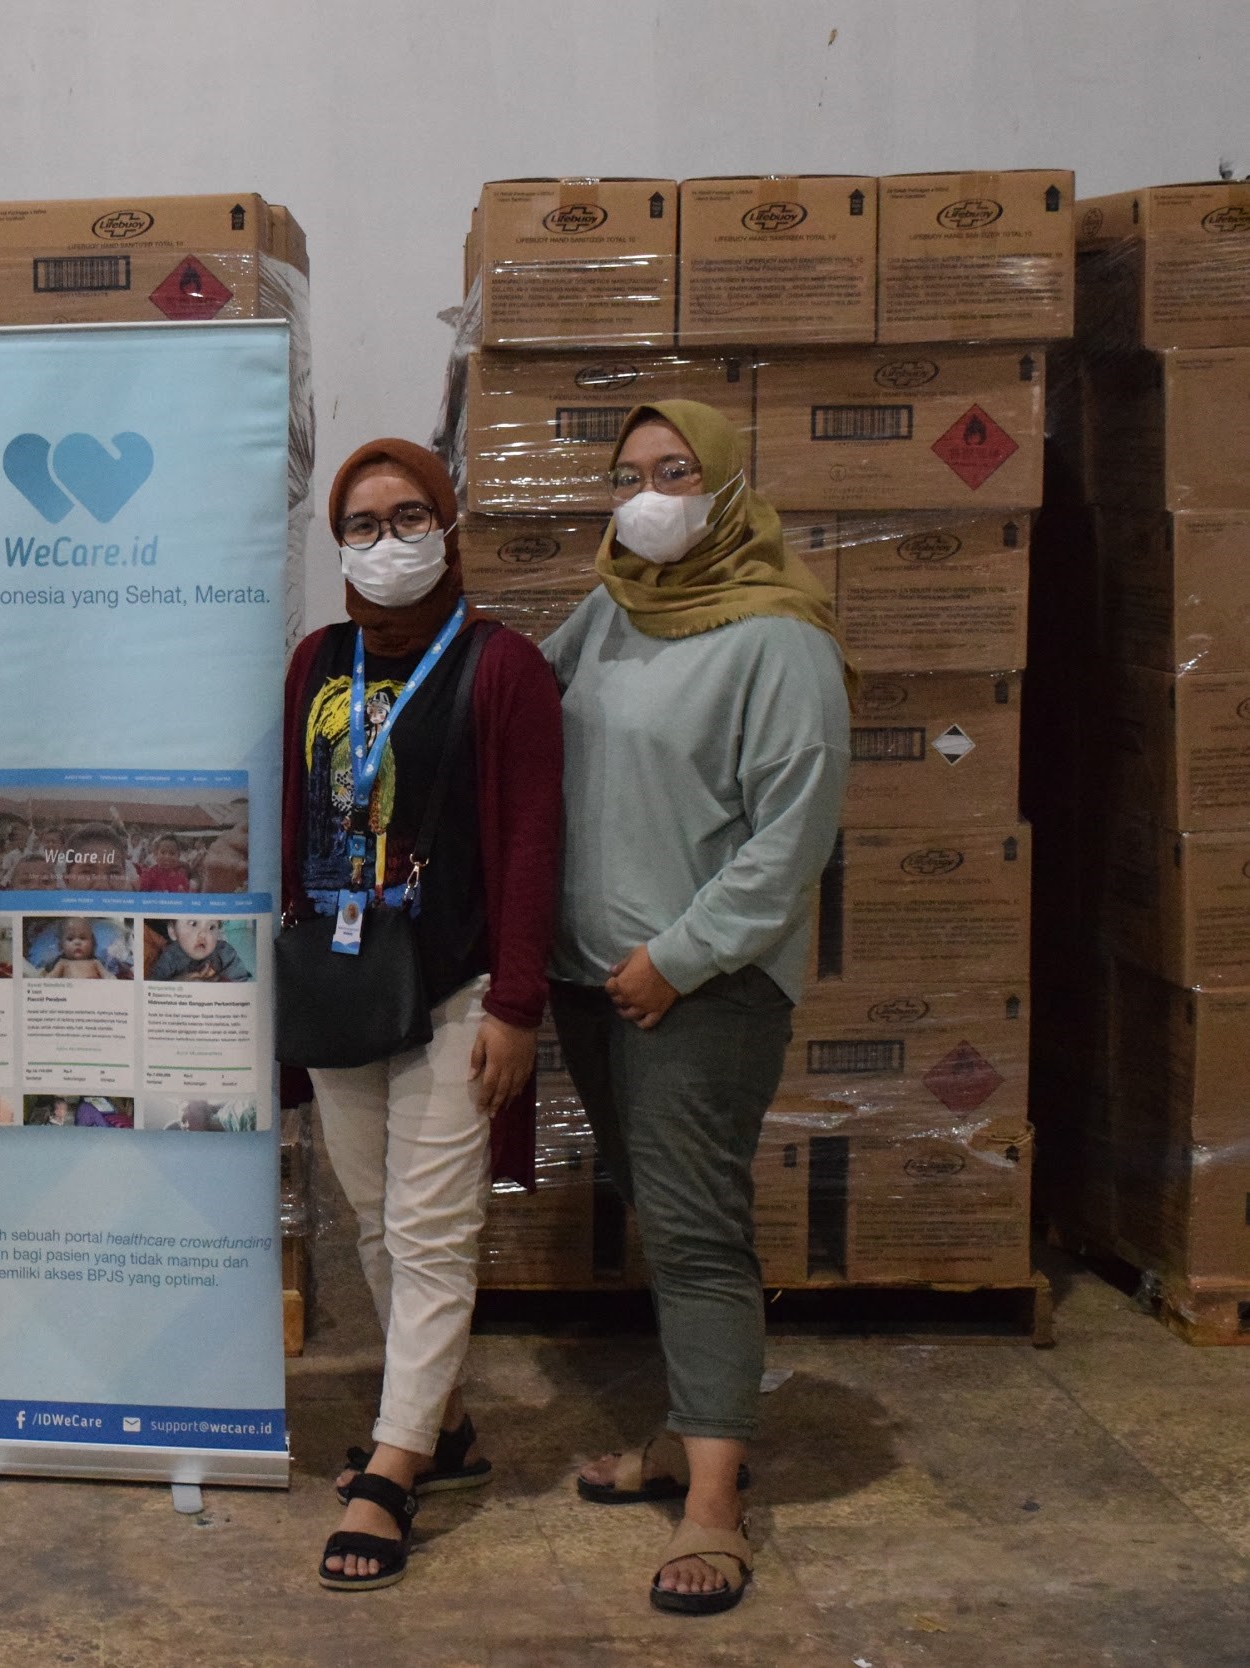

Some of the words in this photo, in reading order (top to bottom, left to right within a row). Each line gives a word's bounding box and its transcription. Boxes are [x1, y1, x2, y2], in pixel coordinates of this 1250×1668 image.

[100, 218, 145, 230] Lifebuoy
[551, 214, 598, 225] Lifebuoy
[750, 212, 798, 222] Lifebuoy
[5, 535, 159, 567] WeCare.id
[71, 590, 119, 609] yang
[125, 585, 187, 607] Sehat,
[195, 585, 271, 604] Merata.
[44, 848, 115, 864] WeCare.id
[11, 1229, 60, 1243] sebuah
[64, 1231, 103, 1247] portal
[107, 1232, 176, 1248] healthcare
[179, 1235, 272, 1252] crowdfunding
[13, 1248, 42, 1263] bagi
[46, 1250, 90, 1264] pasien
[94, 1252, 126, 1267] yang
[130, 1252, 163, 1265] tidak
[167, 1256, 218, 1270] mampu
[222, 1256, 248, 1269] dan
[44, 1267, 84, 1281] akses
[87, 1268, 124, 1283] BPJS
[128, 1272, 161, 1287] yang
[165, 1273, 219, 1288] optimal.
[32, 1412, 103, 1428] /IDWeCare
[151, 1419, 272, 1434] support@wecare.id
